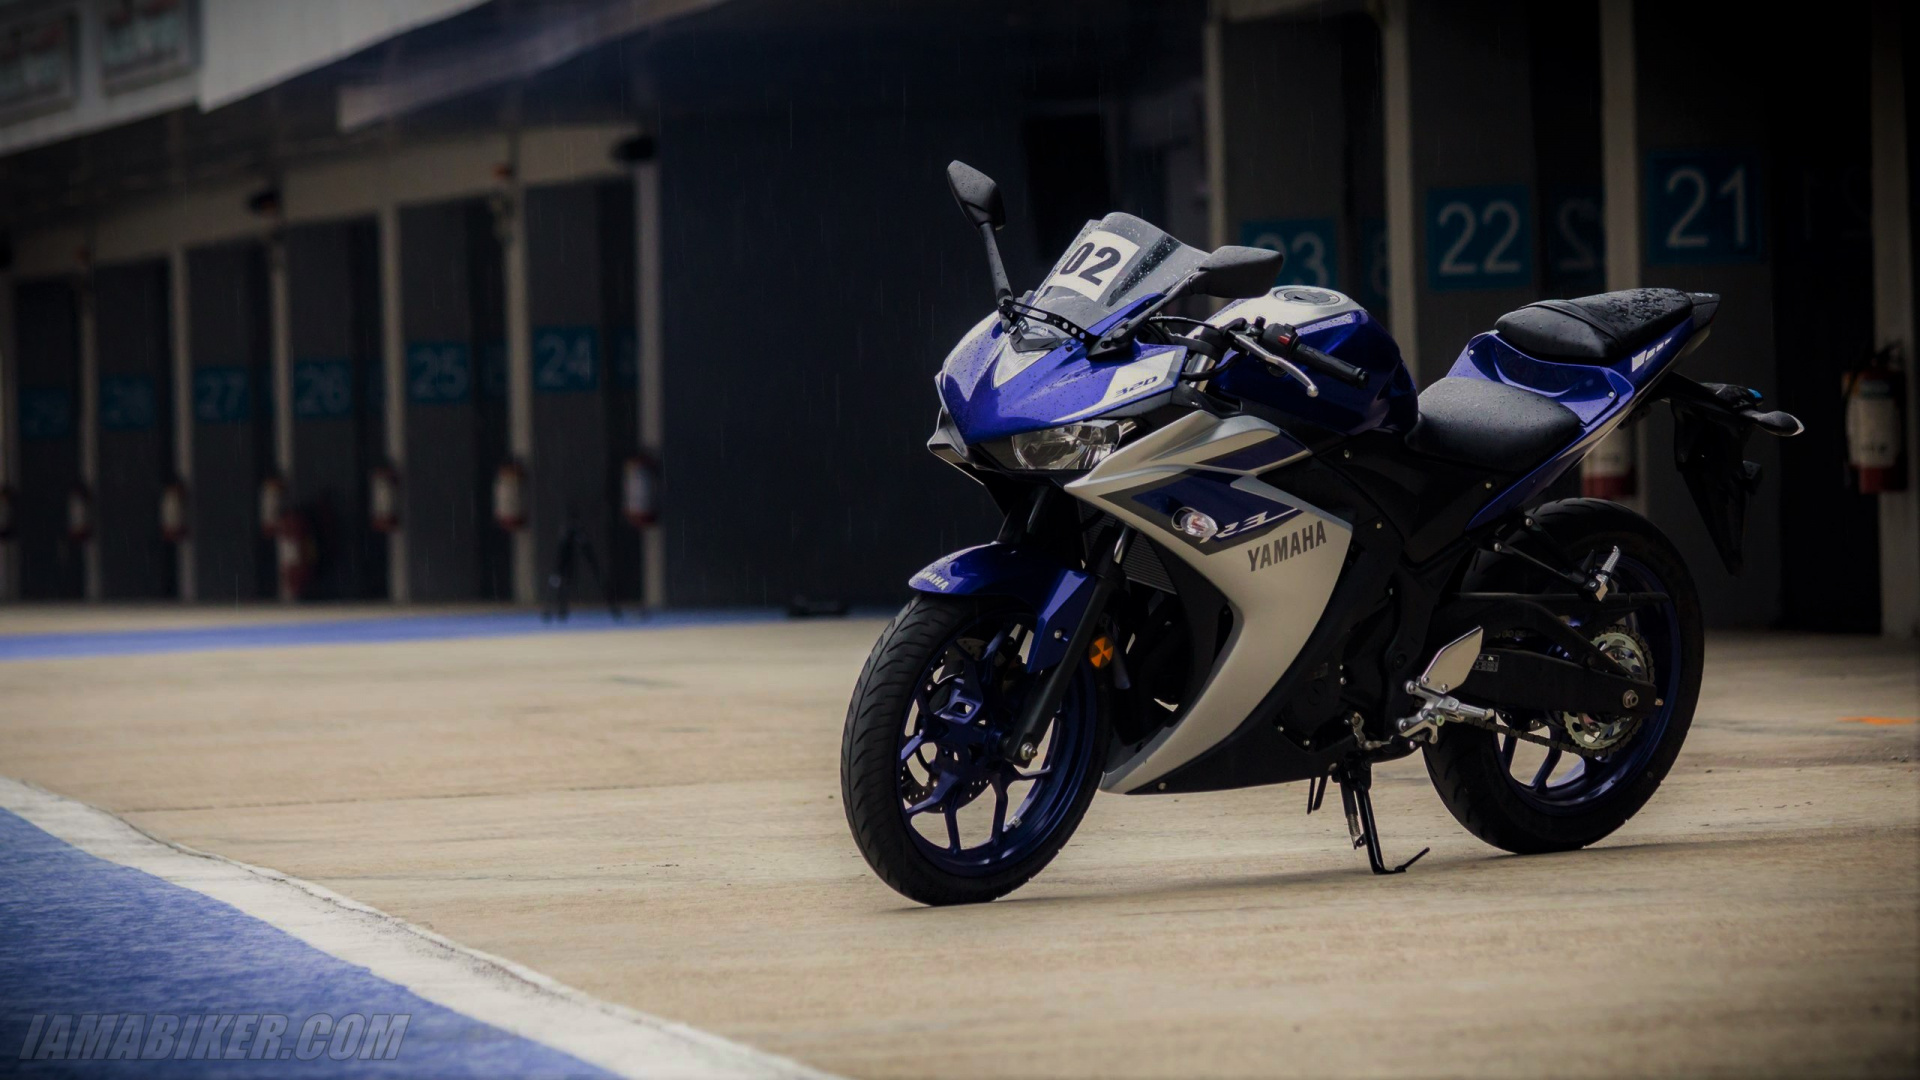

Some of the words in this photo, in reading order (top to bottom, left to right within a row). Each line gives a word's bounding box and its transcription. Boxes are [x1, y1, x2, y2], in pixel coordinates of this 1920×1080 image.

[1664, 162, 1748, 249] 21
[1060, 242, 1121, 286] 02
[1436, 199, 1523, 278] 22
[410, 345, 470, 399] 25
[538, 333, 594, 387] 24
[1247, 520, 1327, 572] YAMAHA
[917, 570, 949, 591] MAHA
